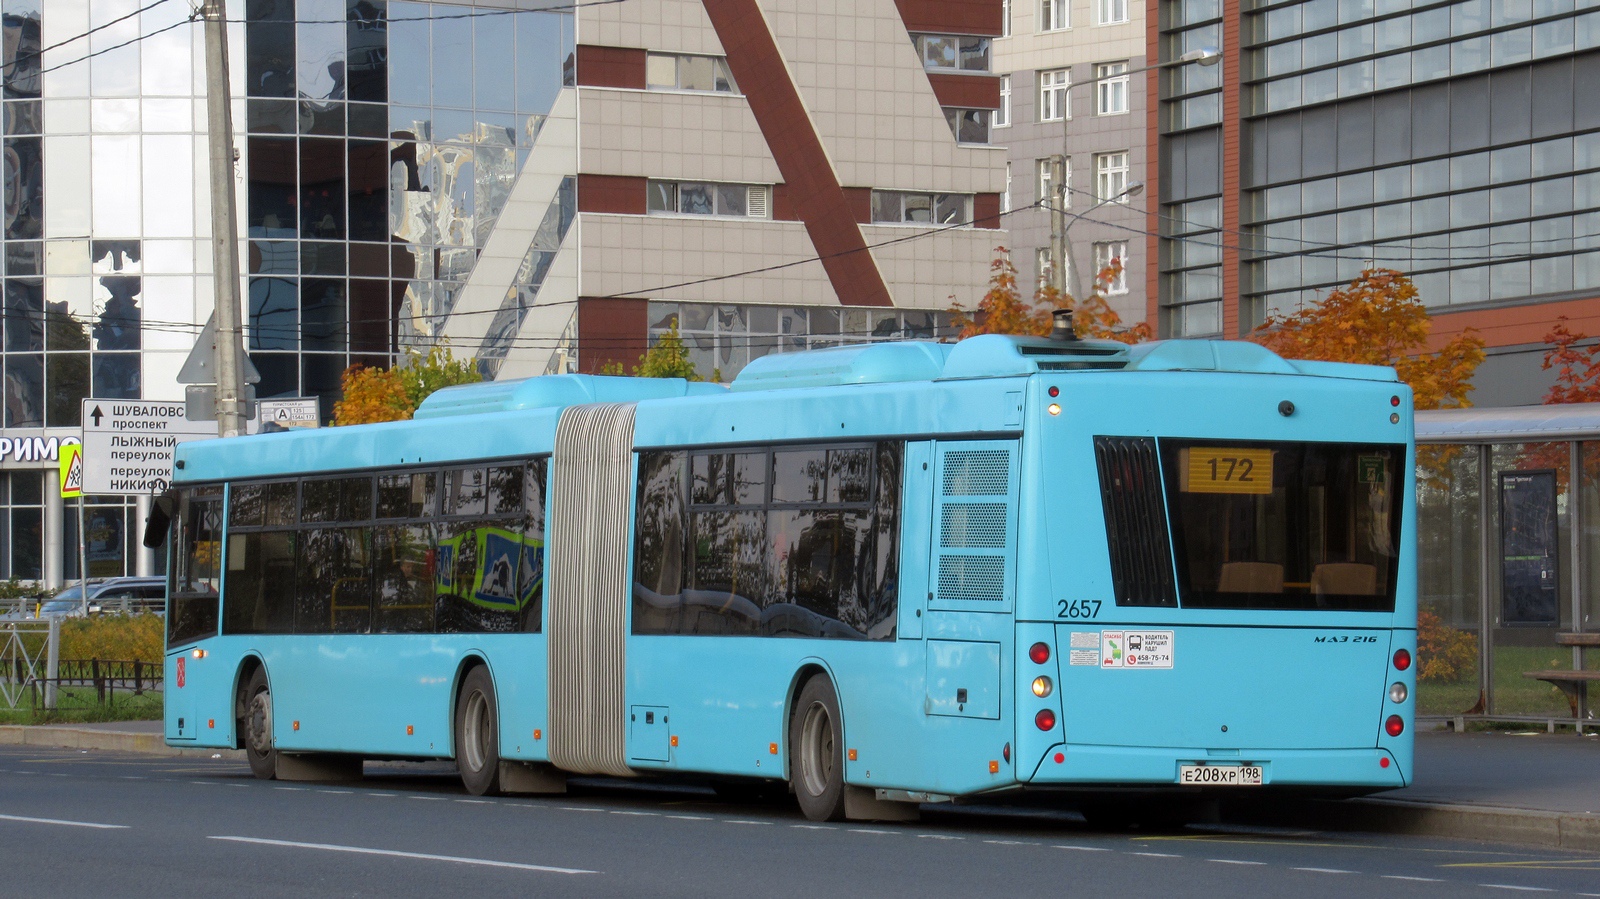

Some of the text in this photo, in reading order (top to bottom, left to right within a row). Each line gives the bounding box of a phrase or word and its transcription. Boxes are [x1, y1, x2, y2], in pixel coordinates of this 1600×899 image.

[112, 405, 184, 418] ШУВАЛОВС
[112, 420, 168, 430] проспект
[110, 435, 177, 447] ЛЫЖНЫЙ
[110, 451, 171, 462] переулок
[110, 467, 171, 478] переулок
[1207, 457, 1254, 482] 172
[1057, 599, 1102, 619] 2657
[1240, 767, 1259, 779] 198
